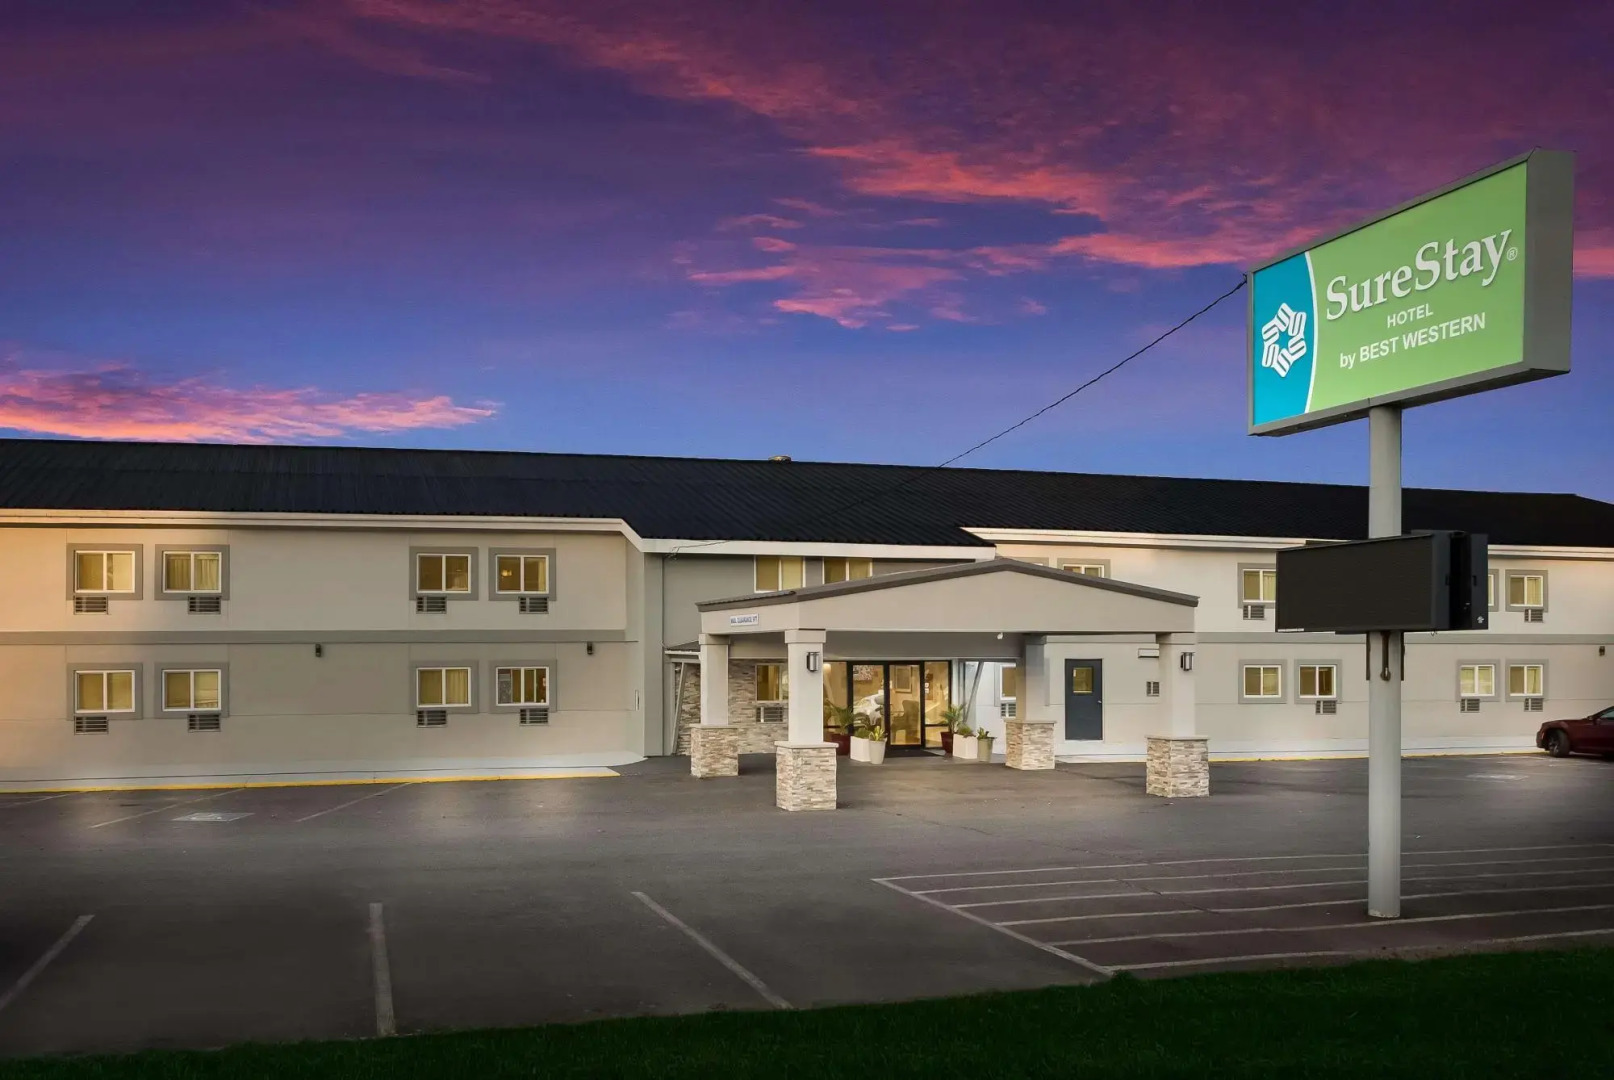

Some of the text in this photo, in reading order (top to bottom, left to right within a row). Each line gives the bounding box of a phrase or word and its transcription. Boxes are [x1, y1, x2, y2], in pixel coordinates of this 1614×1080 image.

[1326, 228, 1513, 321] SureStay
[1339, 311, 1486, 370] by BEST WESTERN
[1386, 303, 1434, 329] HOTEL
